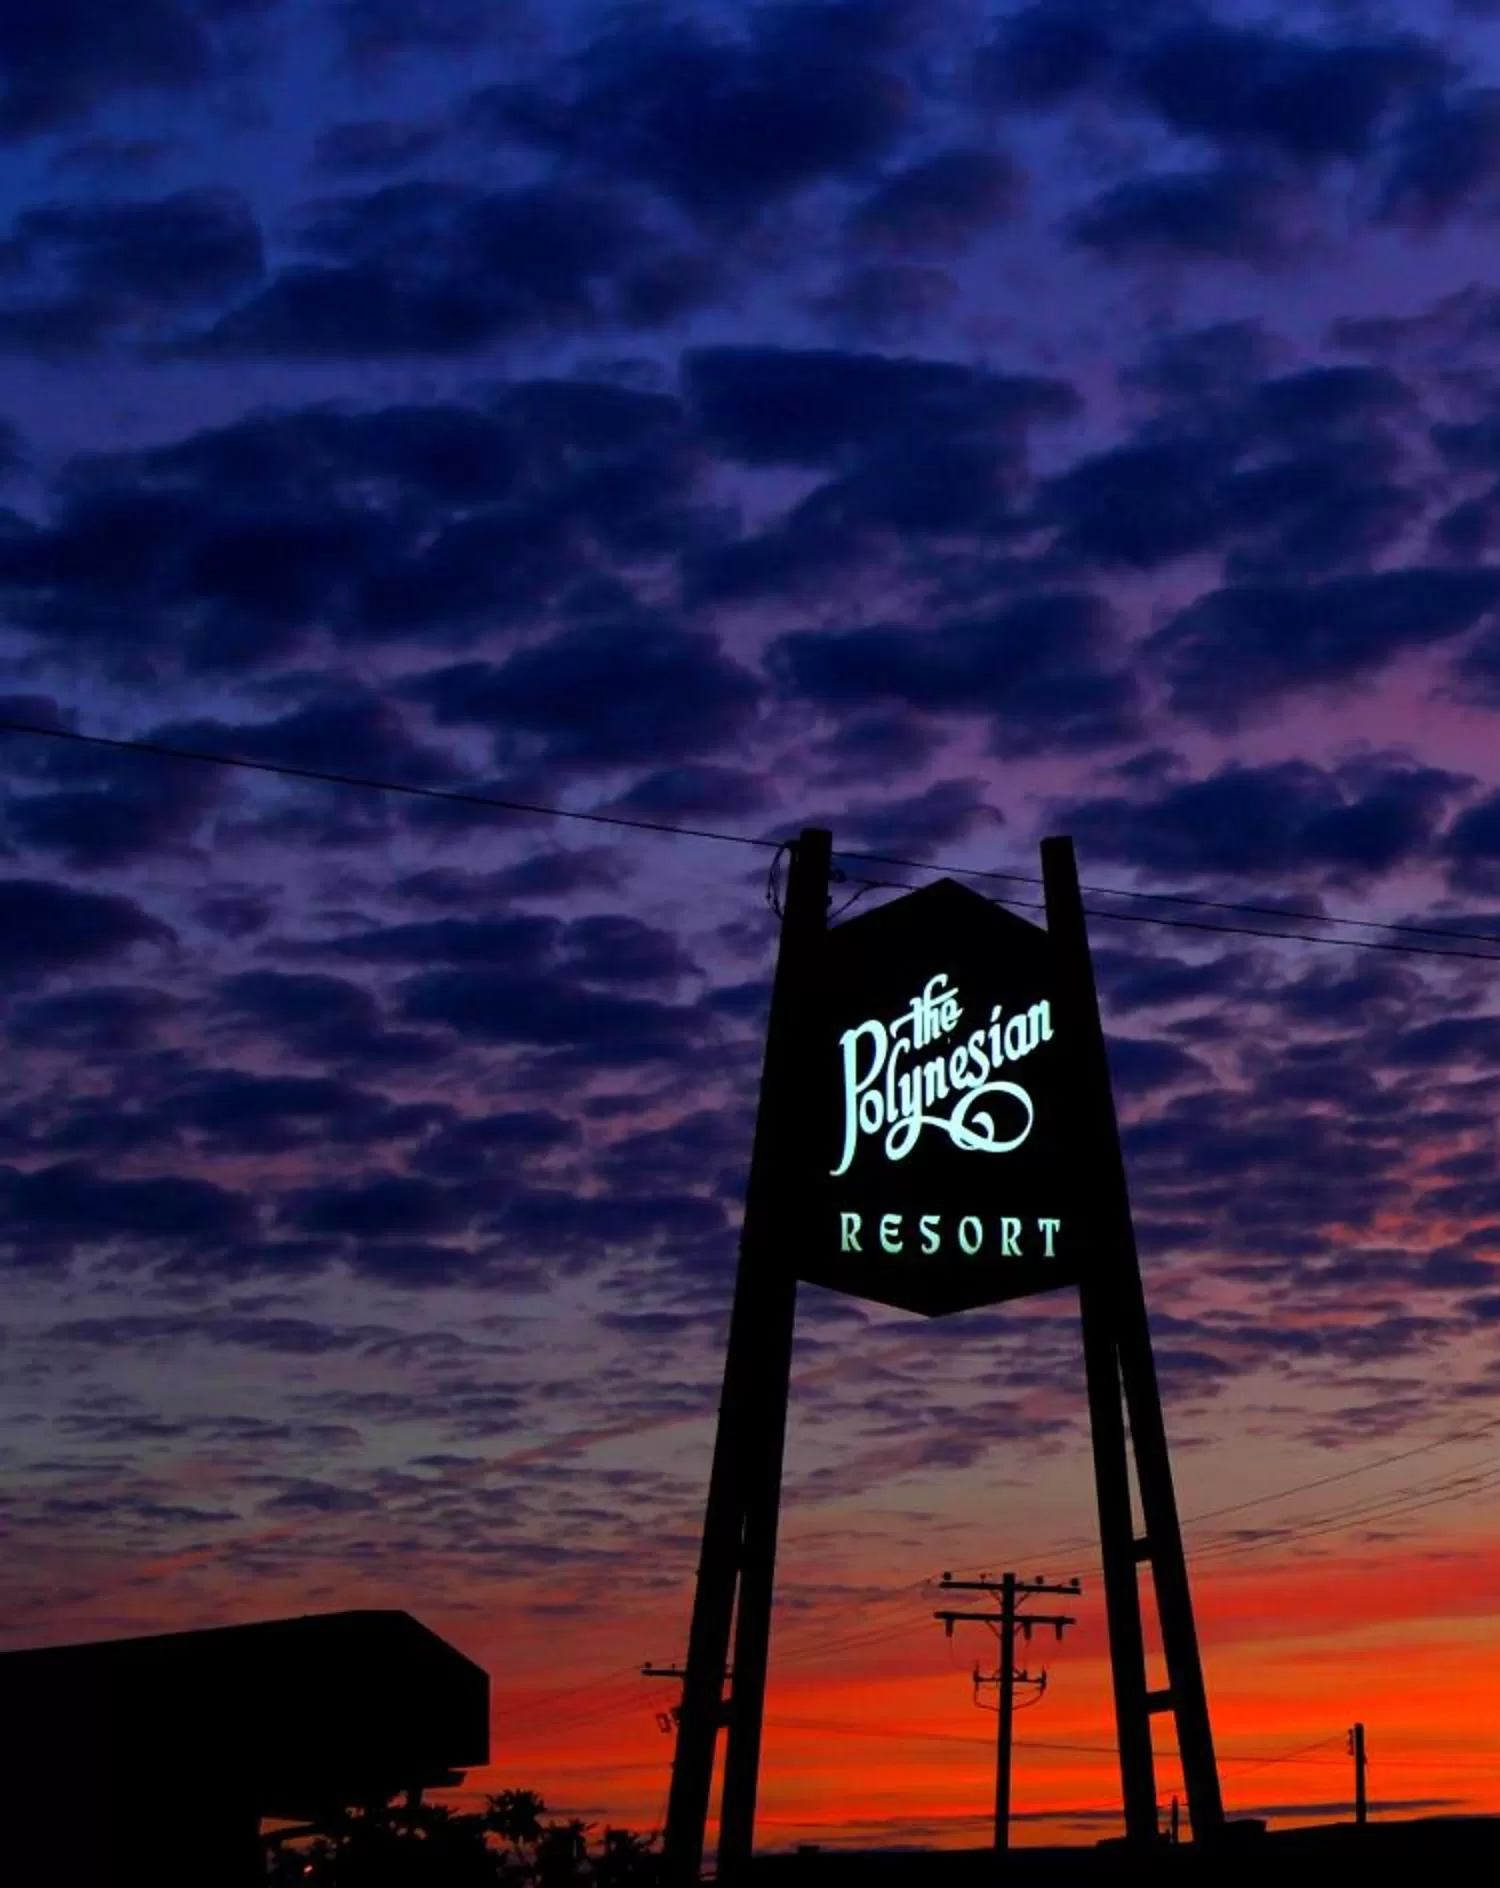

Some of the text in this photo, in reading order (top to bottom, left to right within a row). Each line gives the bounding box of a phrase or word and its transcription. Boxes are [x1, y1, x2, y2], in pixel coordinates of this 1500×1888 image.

[889, 973, 964, 1050] the
[829, 999, 1055, 1176] Polynesian
[840, 1211, 1061, 1257] RESORT
